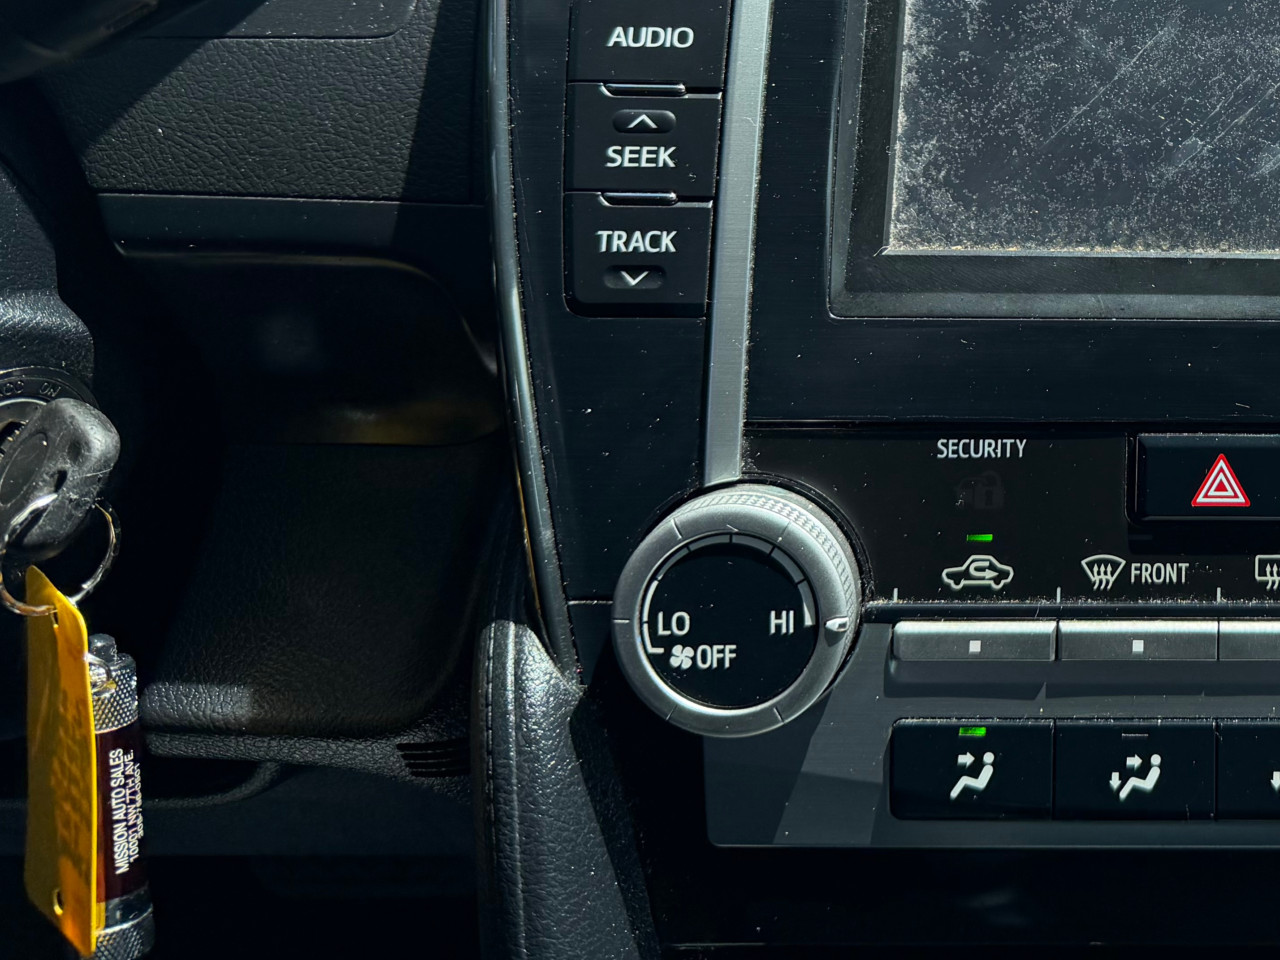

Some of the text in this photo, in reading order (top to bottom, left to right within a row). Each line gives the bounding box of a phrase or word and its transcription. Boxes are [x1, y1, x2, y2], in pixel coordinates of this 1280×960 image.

[606, 26, 694, 49] AUDIO
[605, 145, 677, 168] SEEK
[597, 230, 677, 253] TRACK
[0, 380, 25, 397] CC
[936, 438, 1027, 459] SECURITY
[1130, 562, 1190, 585] FRONT
[657, 611, 691, 636] LO
[769, 610, 795, 635] HI
[696, 644, 737, 669] OFF
[109, 748, 130, 875] MISSION AUTO SALES
[124, 749, 139, 863] 10001 NW 7TH AVE.
